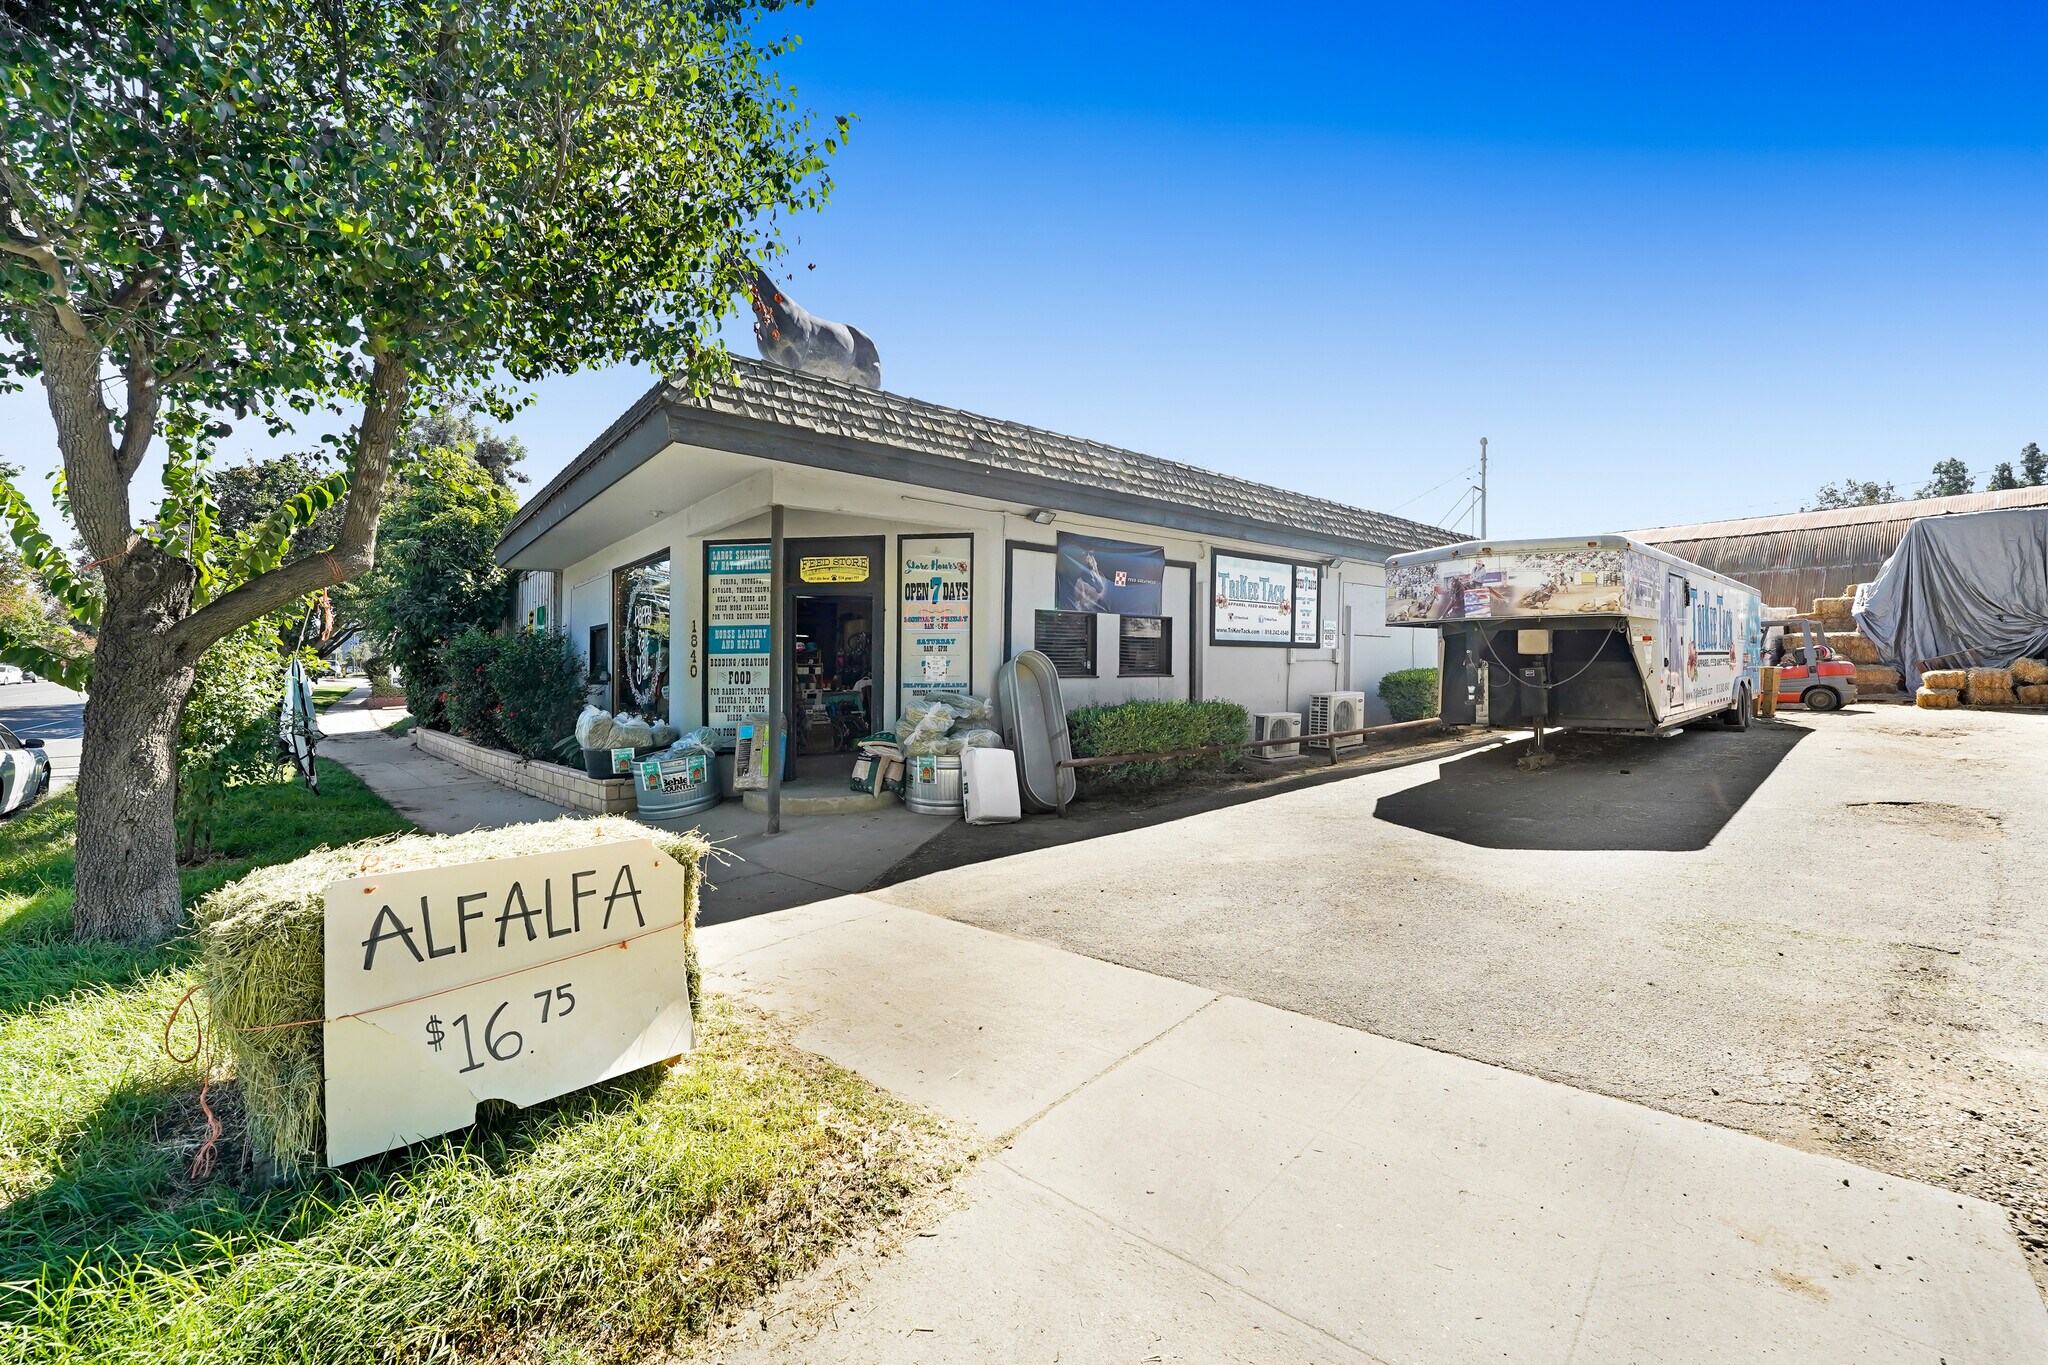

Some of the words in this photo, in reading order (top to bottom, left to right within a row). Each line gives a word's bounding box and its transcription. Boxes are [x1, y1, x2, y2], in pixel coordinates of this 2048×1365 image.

[712, 550, 733, 560] LARGE
[736, 550, 770, 560] SELECTION
[711, 562, 718, 570] OF
[721, 561, 733, 570] HAY
[736, 560, 771, 570] AVAILABLE
[802, 558, 830, 570] FEED
[833, 558, 867, 568] STORE
[904, 559, 928, 574] Store
[930, 559, 958, 571] Hours
[905, 583, 929, 600] OPEN
[930, 577, 942, 604] 7
[943, 582, 968, 600] DAYS
[715, 630, 735, 639] HORSE
[738, 629, 767, 638] LAUNDRY
[722, 640, 734, 649] AND
[737, 640, 760, 649] REPAIR
[710, 658, 770, 667] BEDDING/SHAVING
[728, 671, 751, 684] FOOD
[723, 728, 736, 736] FOOD
[663, 777, 687, 787] Behle
[362, 864, 646, 971] ALFALFA
